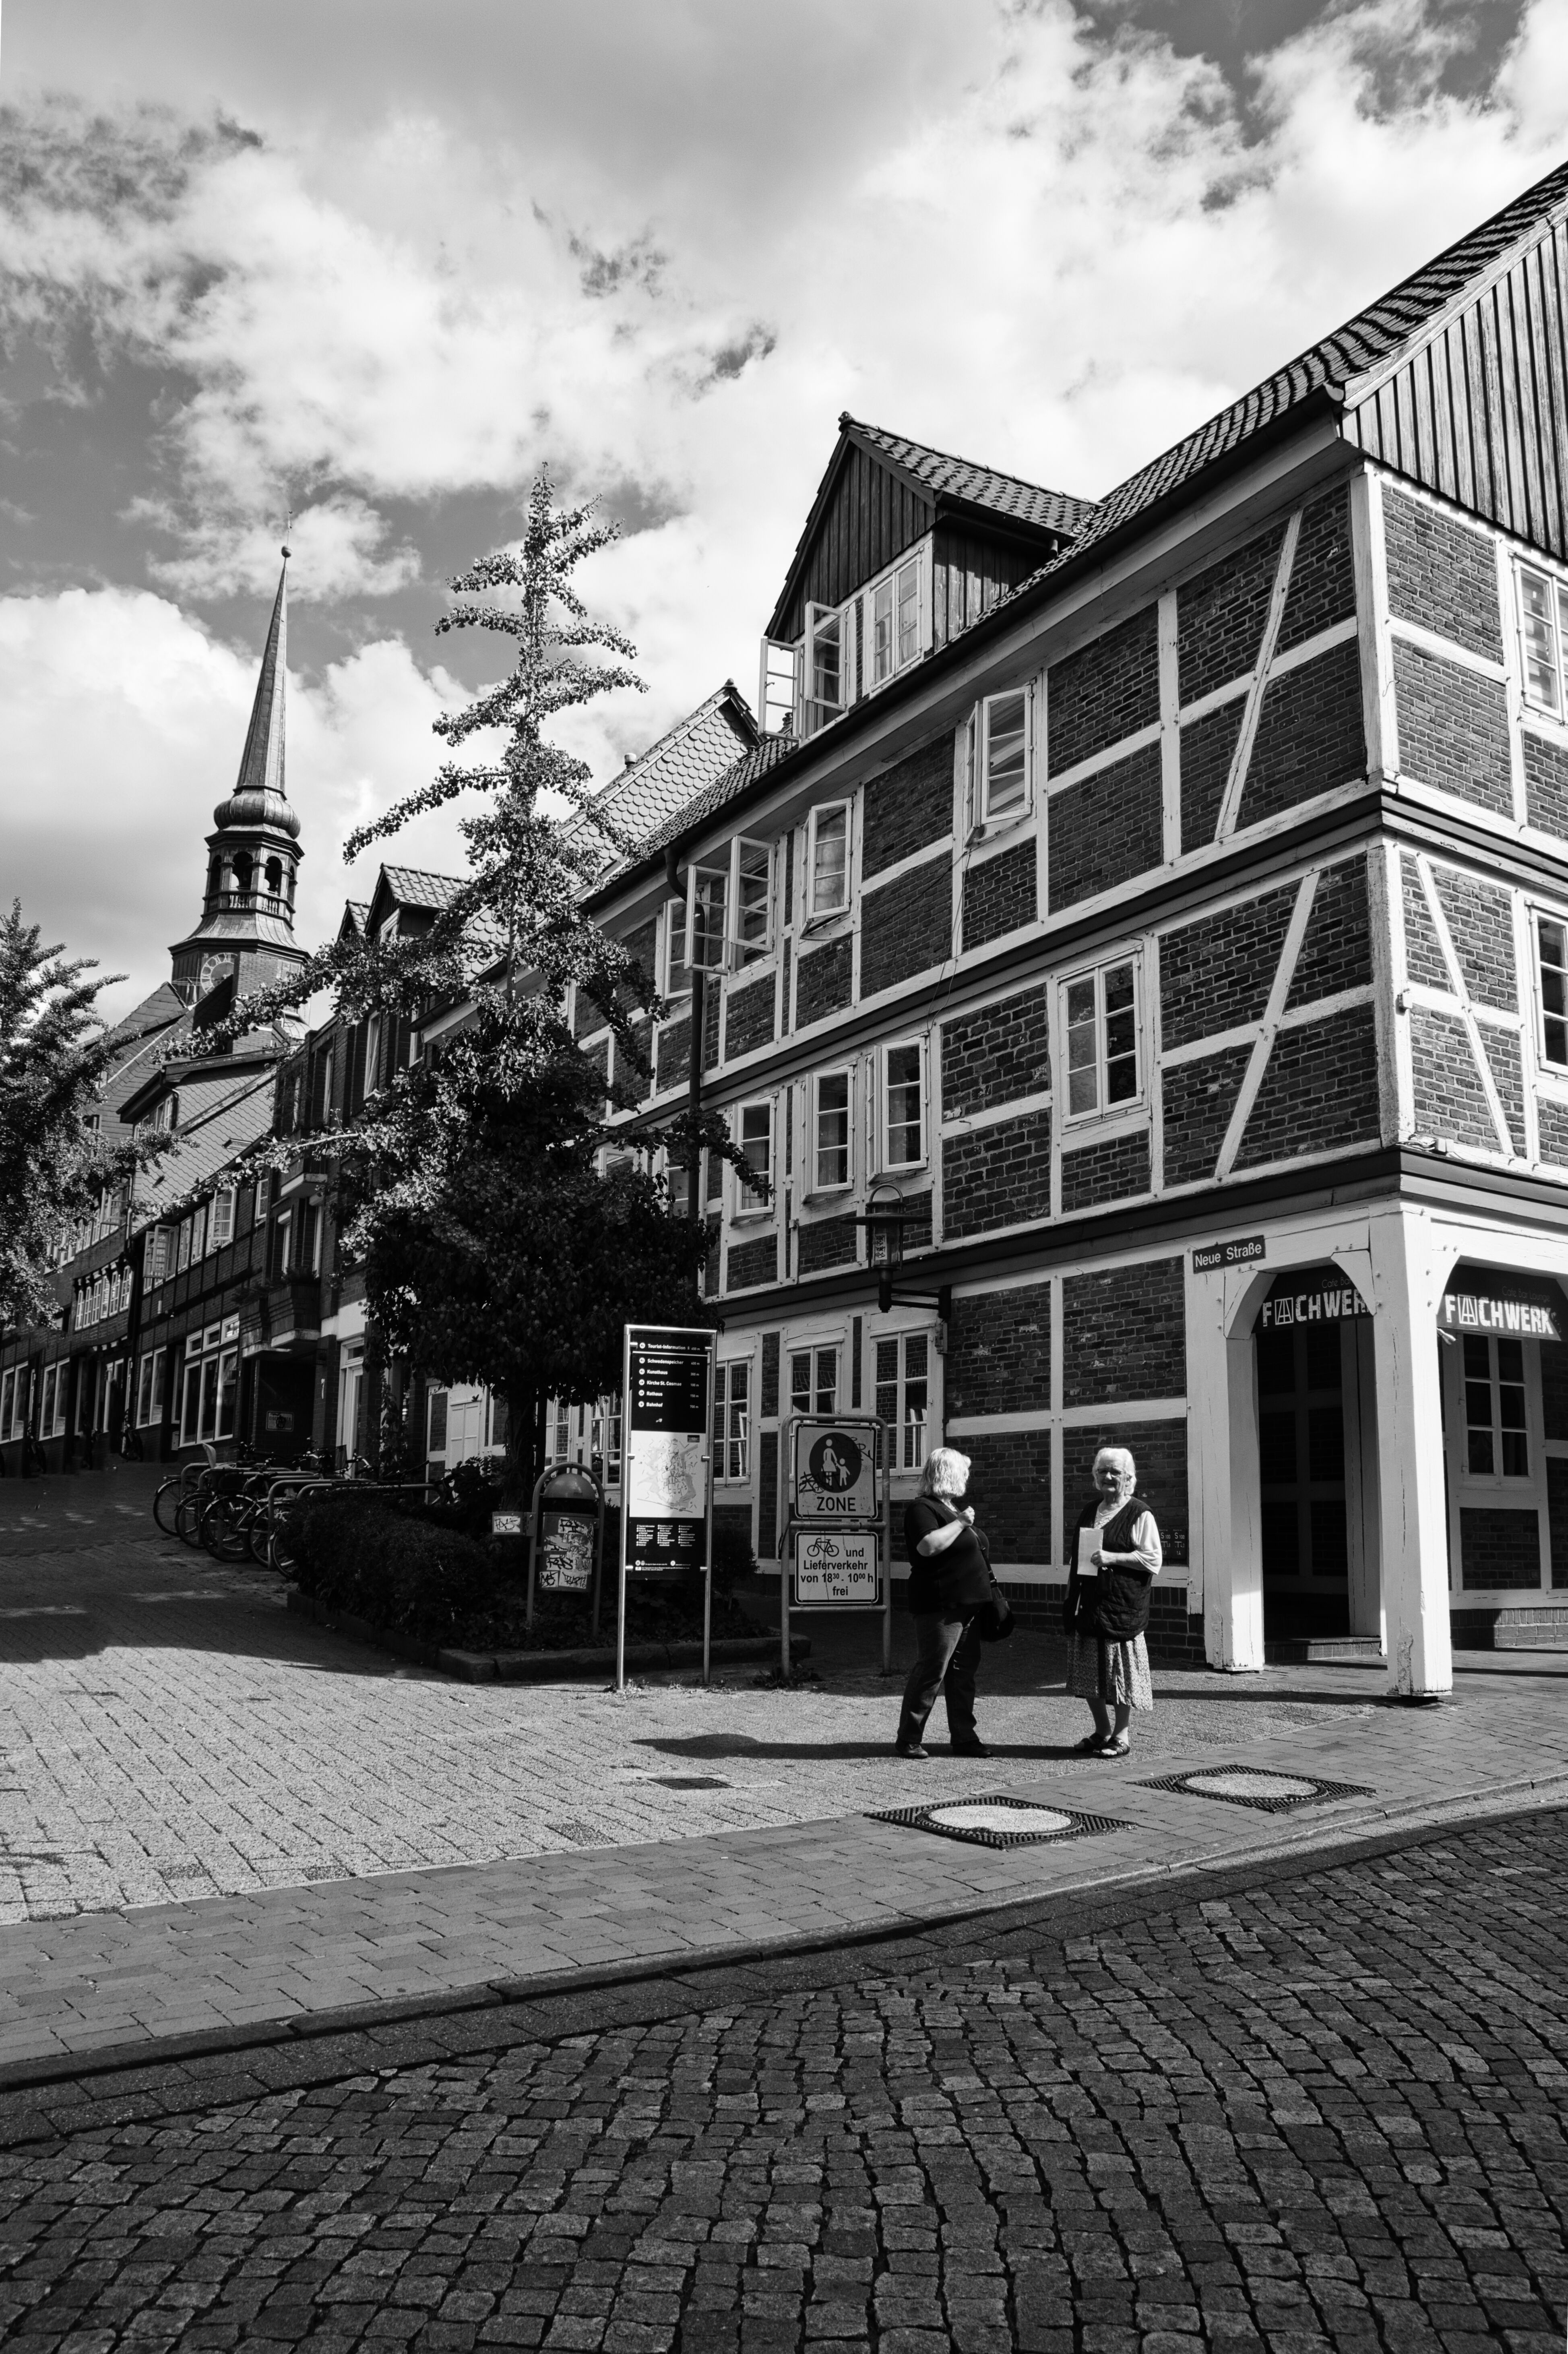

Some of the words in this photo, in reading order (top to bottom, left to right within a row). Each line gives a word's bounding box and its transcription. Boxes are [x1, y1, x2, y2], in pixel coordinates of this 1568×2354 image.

[1195, 1253, 1221, 1267] Neue
[1226, 1242, 1262, 1260] Straße
[1322, 1279, 1338, 1288] Cafe
[1502, 1286, 1516, 1297] Cafe
[1518, 1288, 1528, 1298] Bar
[1529, 1290, 1550, 1303] Lounge
[1262, 1289, 1370, 1327] FACHWER
[1445, 1294, 1554, 1335] FACHWERK
[816, 1496, 856, 1511] ZONE
[846, 1548, 864, 1557] und
[804, 1560, 868, 1570] Lieferverkehr
[868, 1573, 874, 1583] h
[833, 1586, 848, 1596] frei
